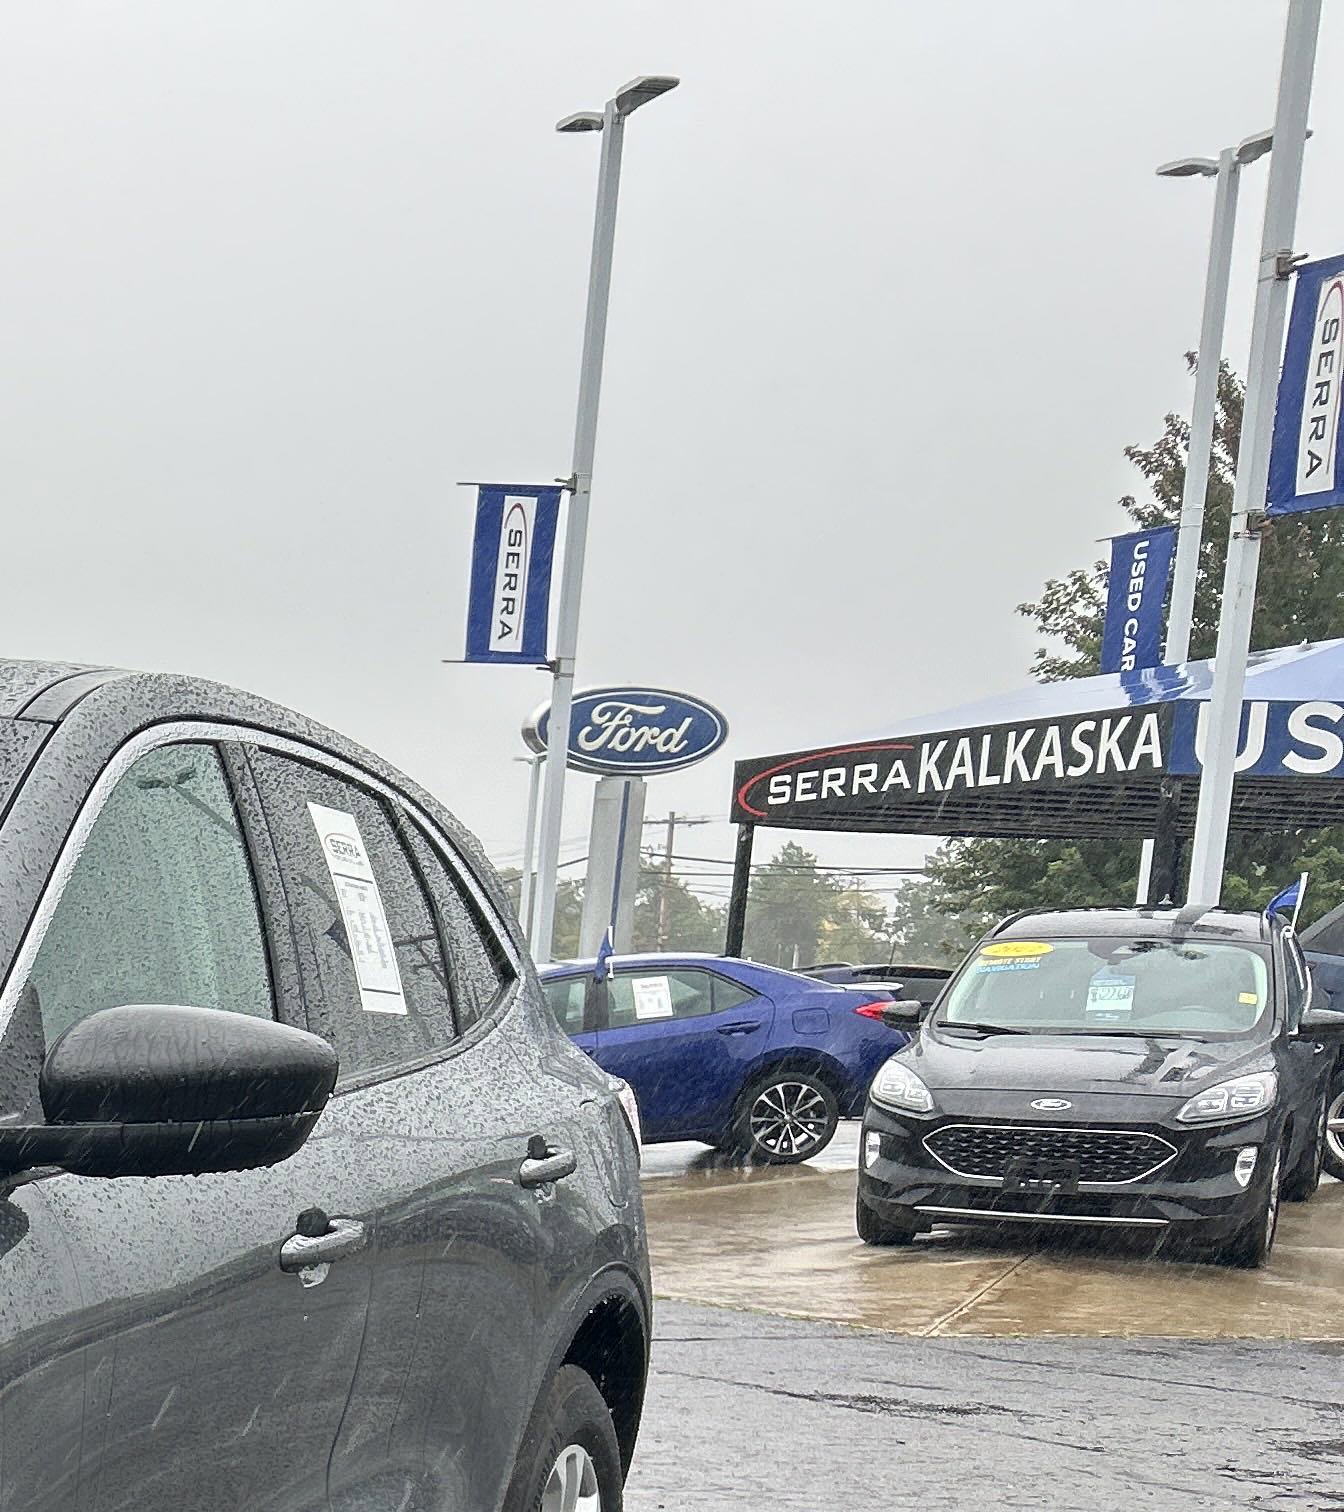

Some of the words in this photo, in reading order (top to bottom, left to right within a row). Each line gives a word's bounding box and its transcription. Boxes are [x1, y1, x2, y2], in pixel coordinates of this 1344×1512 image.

[1305, 317, 1340, 479] SERRA
[498, 528, 522, 641] SERRA
[1127, 540, 1150, 612] USED
[578, 701, 694, 754] Ford
[767, 760, 912, 805] SERRA
[916, 712, 1164, 794] KALKASKA
